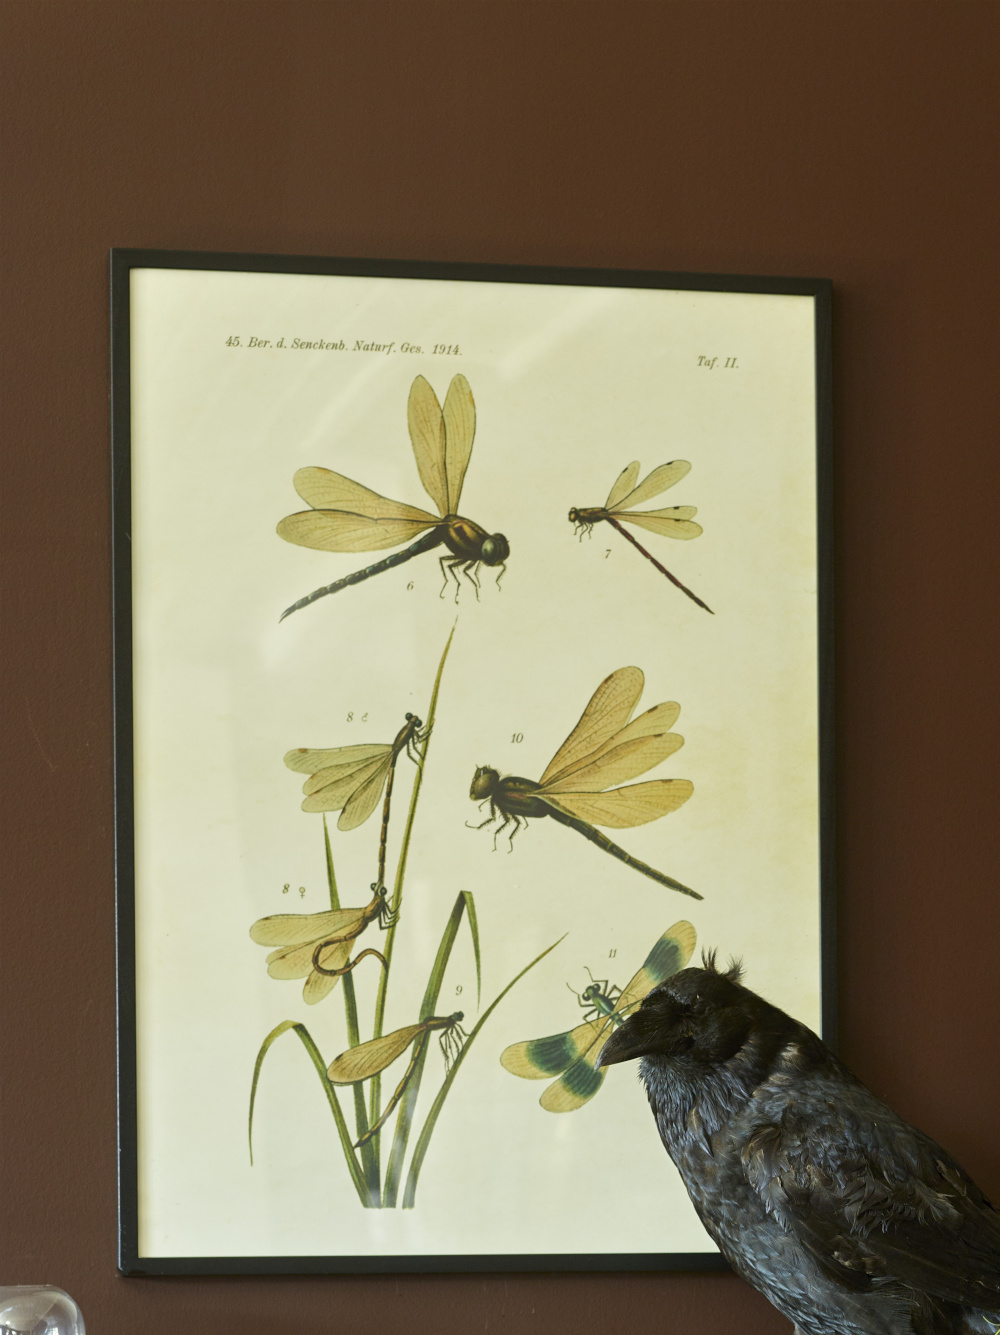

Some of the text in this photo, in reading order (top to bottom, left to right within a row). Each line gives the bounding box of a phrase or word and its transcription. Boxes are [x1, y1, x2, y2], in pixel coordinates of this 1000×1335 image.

[226, 336, 462, 356] 45. Ber. d. Senckenb. Naturf. Ges. 1914.
[697, 356, 739, 370] Taf. II.
[605, 549, 612, 559] 7
[407, 581, 414, 591] 6
[347, 712, 354, 722] 8
[511, 733, 524, 743] 10
[282, 883, 290, 894] 8
[608, 949, 617, 958] 11
[456, 985, 463, 996] 9
